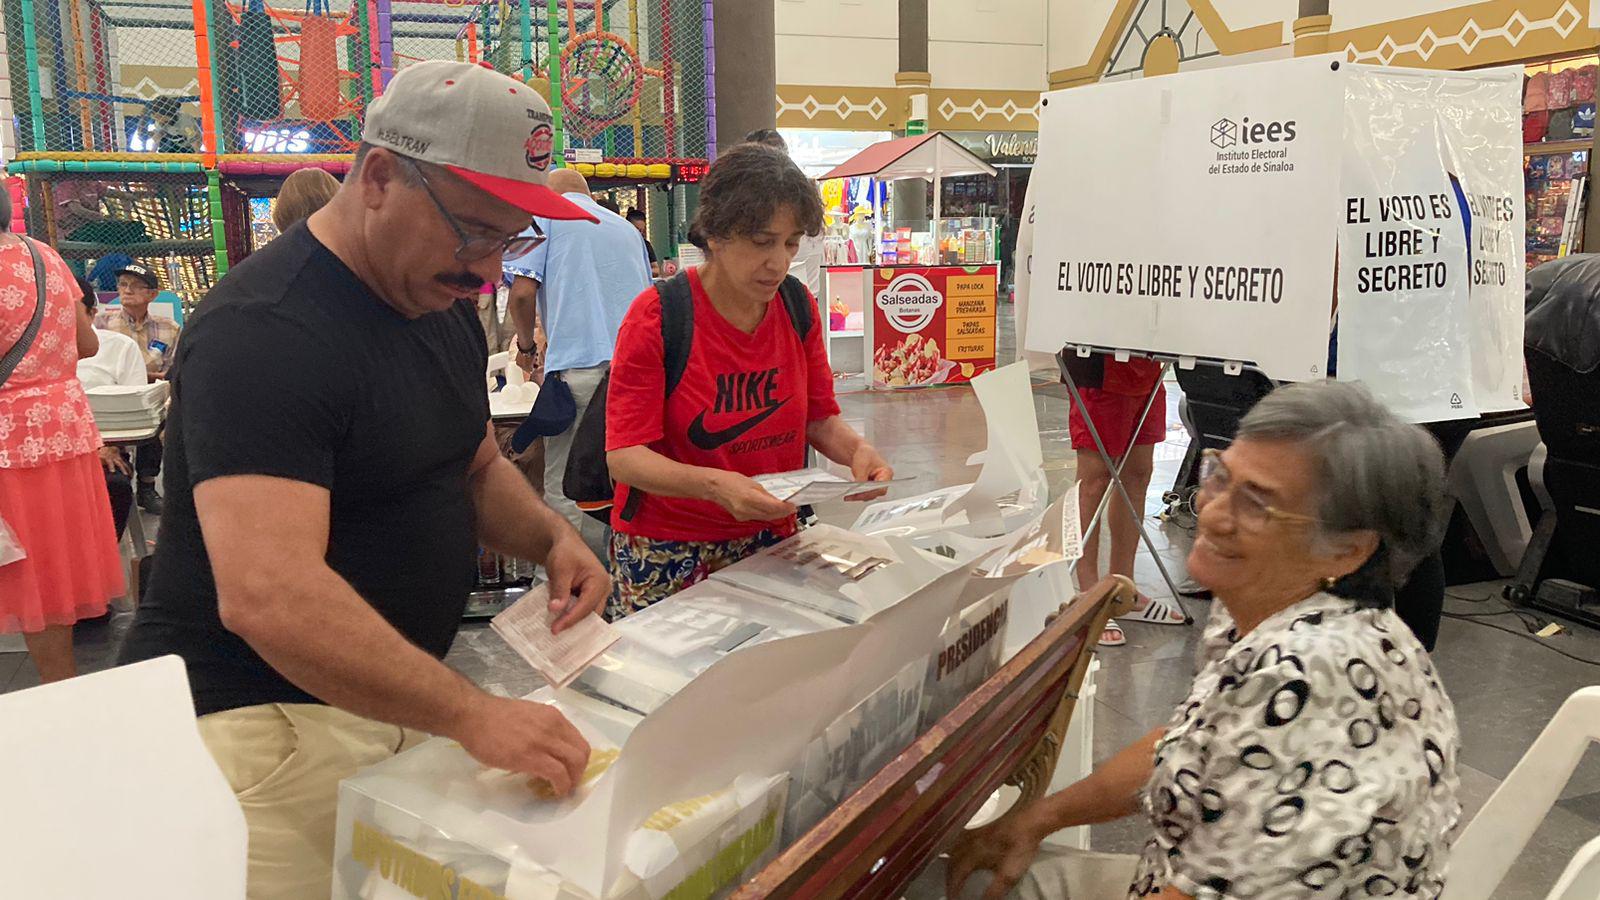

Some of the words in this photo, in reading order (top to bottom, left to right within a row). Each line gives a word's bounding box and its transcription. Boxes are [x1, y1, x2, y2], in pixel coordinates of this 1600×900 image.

[1241, 116, 1297, 145] iees
[1208, 164, 1220, 175] del
[1222, 163, 1249, 174] Estado
[1251, 162, 1261, 173] de
[1263, 161, 1294, 173] Sinaloa
[1216, 150, 1250, 161] Instituto
[1251, 147, 1287, 160] Electoral
[1346, 197, 1371, 224] EL
[1379, 193, 1426, 222] VOTO
[1429, 192, 1452, 219] ES
[1495, 197, 1514, 222] ES
[1365, 229, 1423, 258] LIBRE
[1430, 227, 1442, 254] Y
[1057, 261, 1073, 292] EL
[1077, 261, 1113, 294] VOTO
[1116, 263, 1134, 295] ES
[1138, 263, 1182, 298] LIBRE
[1188, 265, 1199, 299] Y
[1203, 265, 1284, 304] SECRETO
[1357, 261, 1447, 294] SECRETO
[881, 294, 938, 305] Salseadas
[713, 367, 779, 414] NIKE
